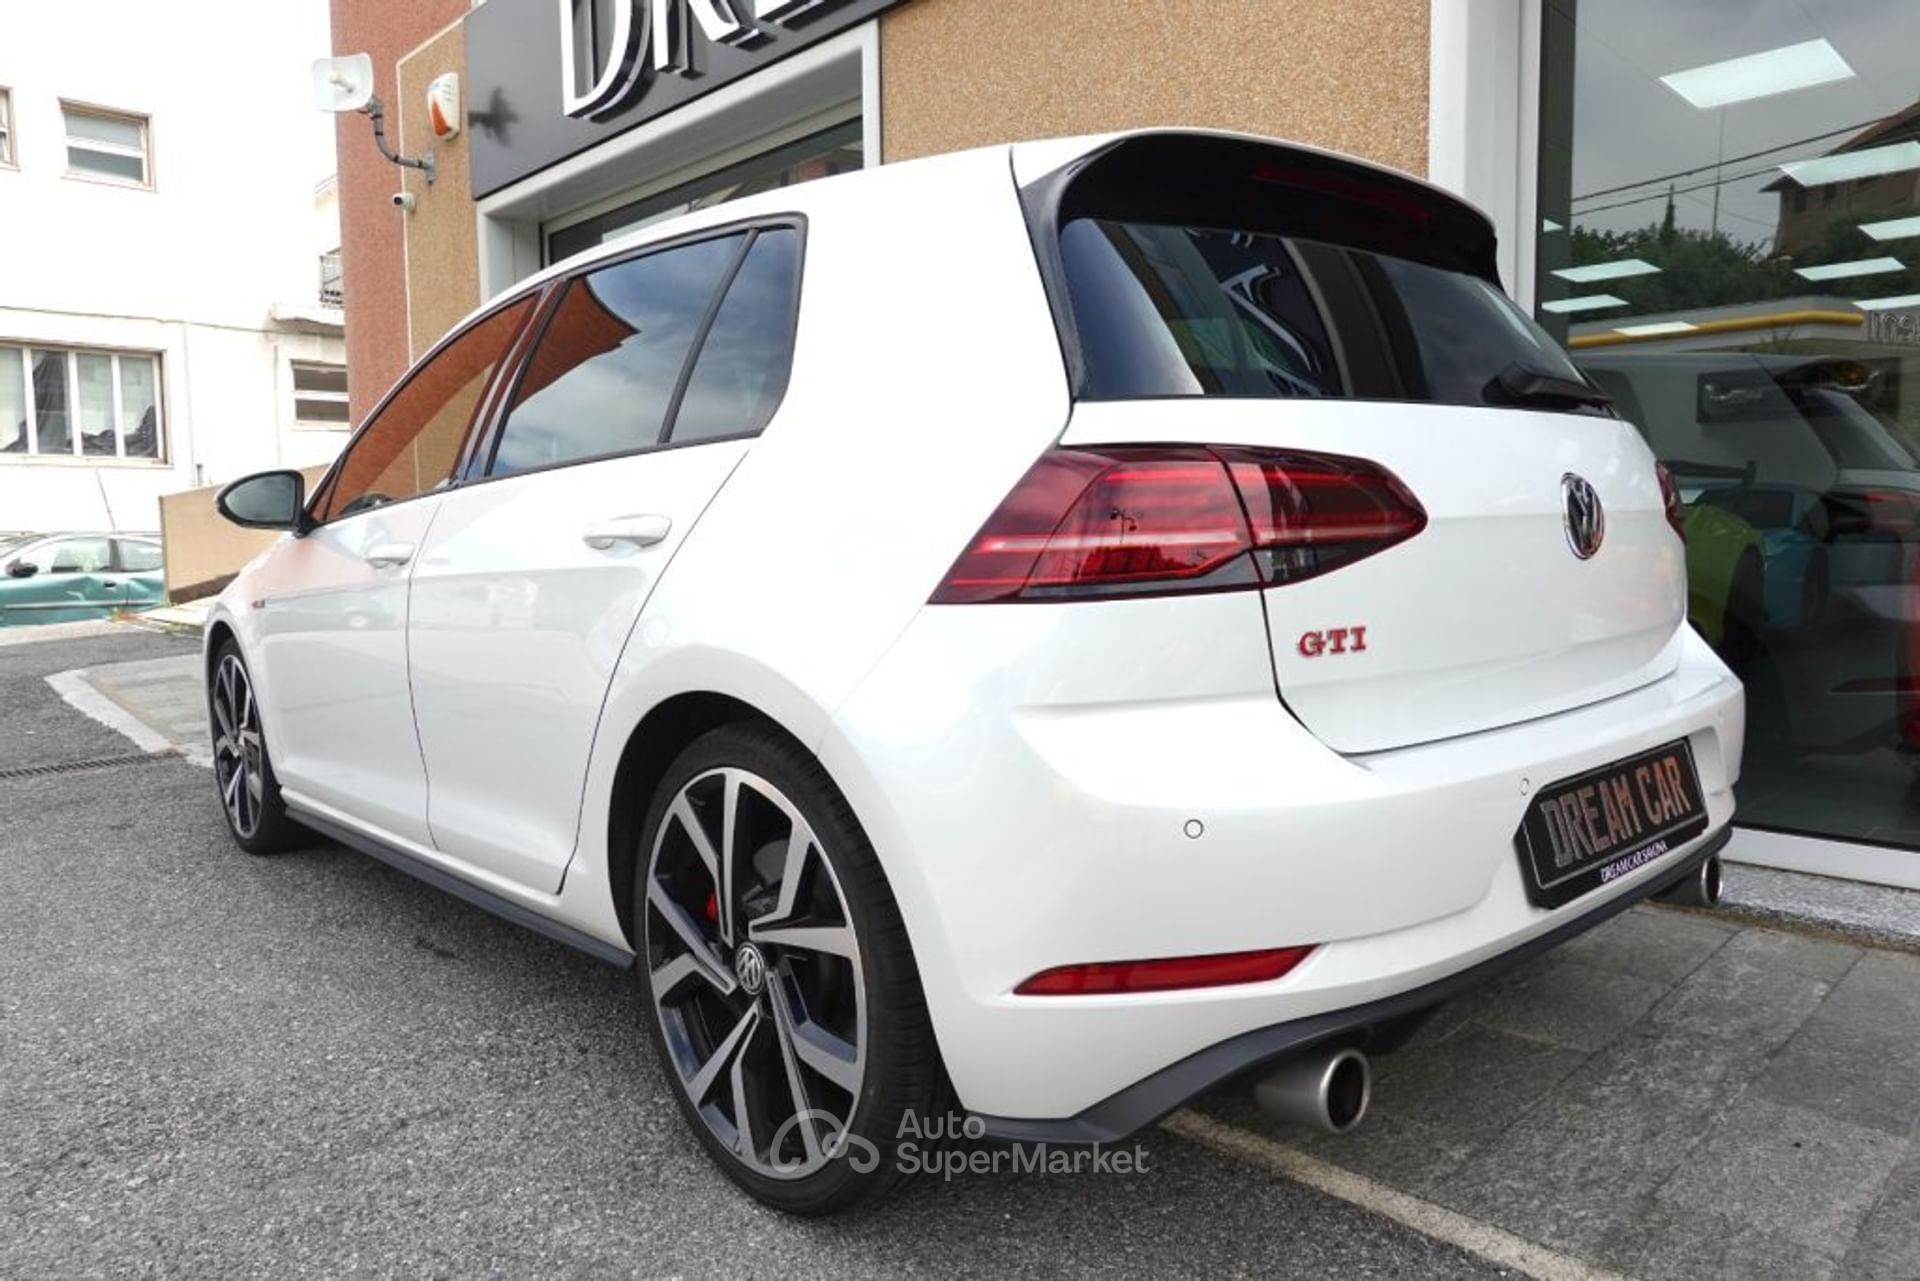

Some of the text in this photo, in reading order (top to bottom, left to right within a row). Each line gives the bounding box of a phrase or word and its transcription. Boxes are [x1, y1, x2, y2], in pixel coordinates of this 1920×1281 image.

[1297, 626, 1366, 657] GTI
[1539, 755, 1691, 868] DREAM CAR
